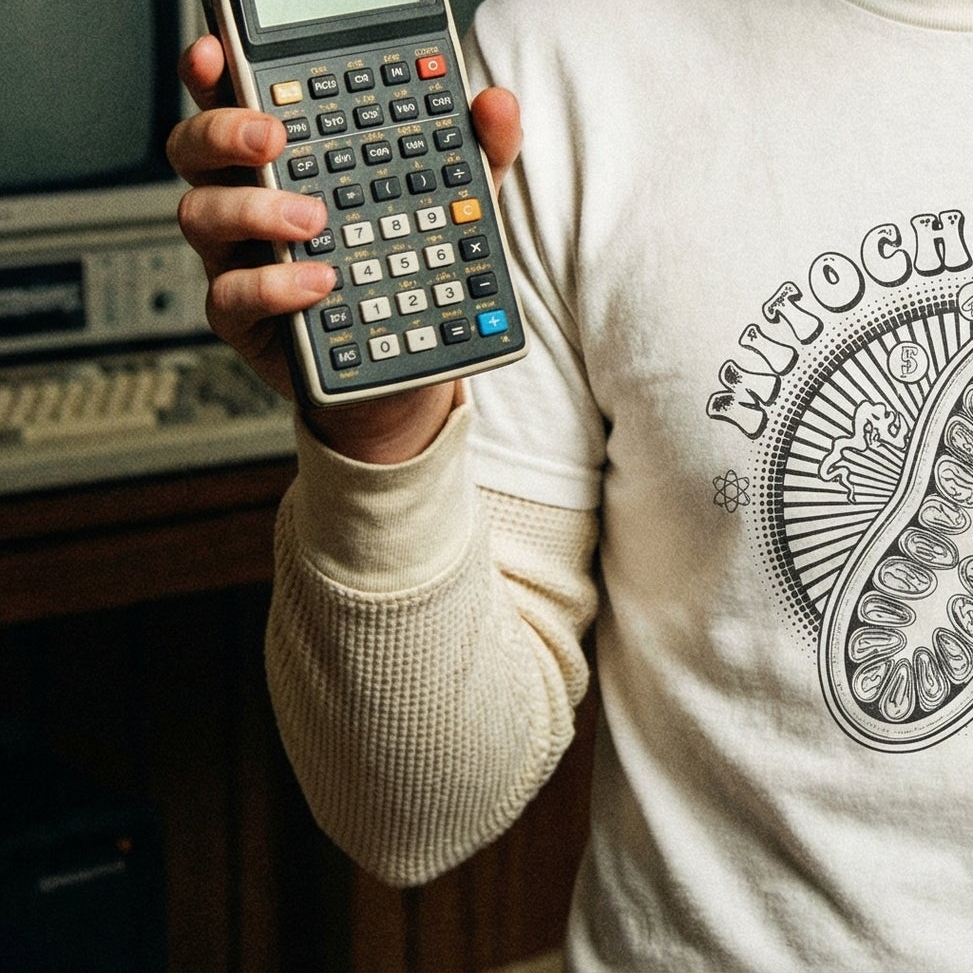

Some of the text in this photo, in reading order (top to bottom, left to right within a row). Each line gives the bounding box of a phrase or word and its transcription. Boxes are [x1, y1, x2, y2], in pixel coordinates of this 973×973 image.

[427, 212, 437, 224] 9
[392, 219, 401, 231] 8
[354, 227, 363, 239] 7
[436, 249, 446, 261] 6
[400, 257, 410, 269] 5
[363, 265, 373, 276] 4
[444, 287, 455, 299] 3
[408, 295, 418, 307] 2
[373, 303, 380, 315] 1
[380, 340, 391, 353] 0
